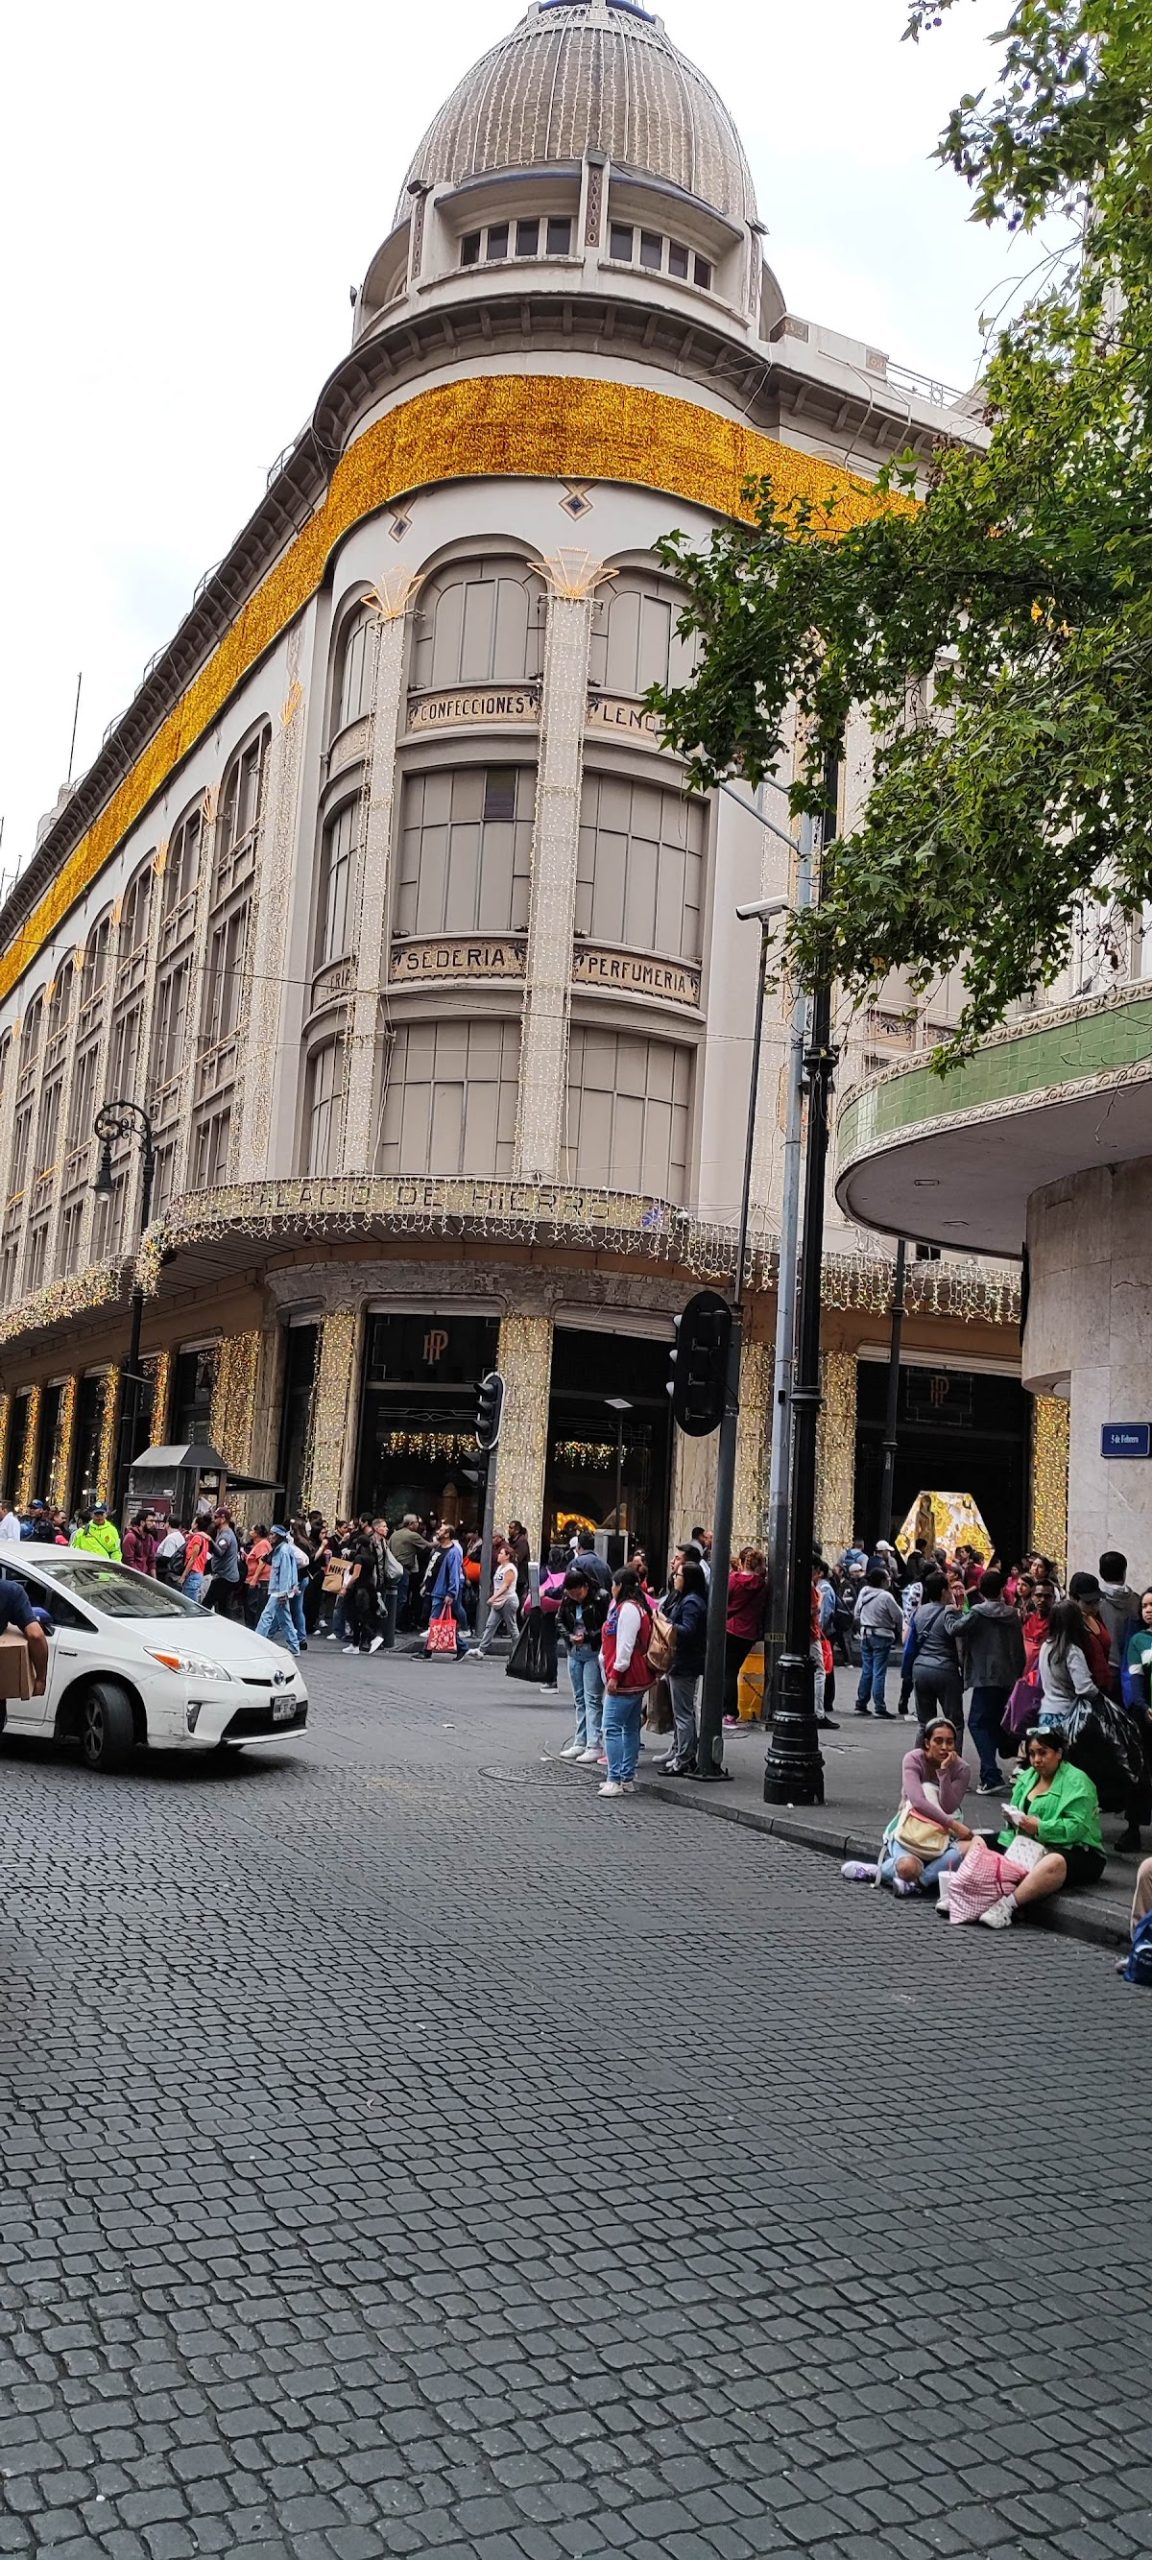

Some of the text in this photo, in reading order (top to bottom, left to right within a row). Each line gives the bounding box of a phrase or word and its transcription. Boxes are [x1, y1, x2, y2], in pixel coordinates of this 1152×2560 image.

[420, 696, 525, 722] CONFECCIONES
[603, 704, 666, 732] LENCE
[406, 948, 506, 971] SEDERIA
[588, 957, 687, 993] PERFUMERIA
[397, 1186, 442, 1207] DE
[472, 1188, 610, 1219] HIERRO
